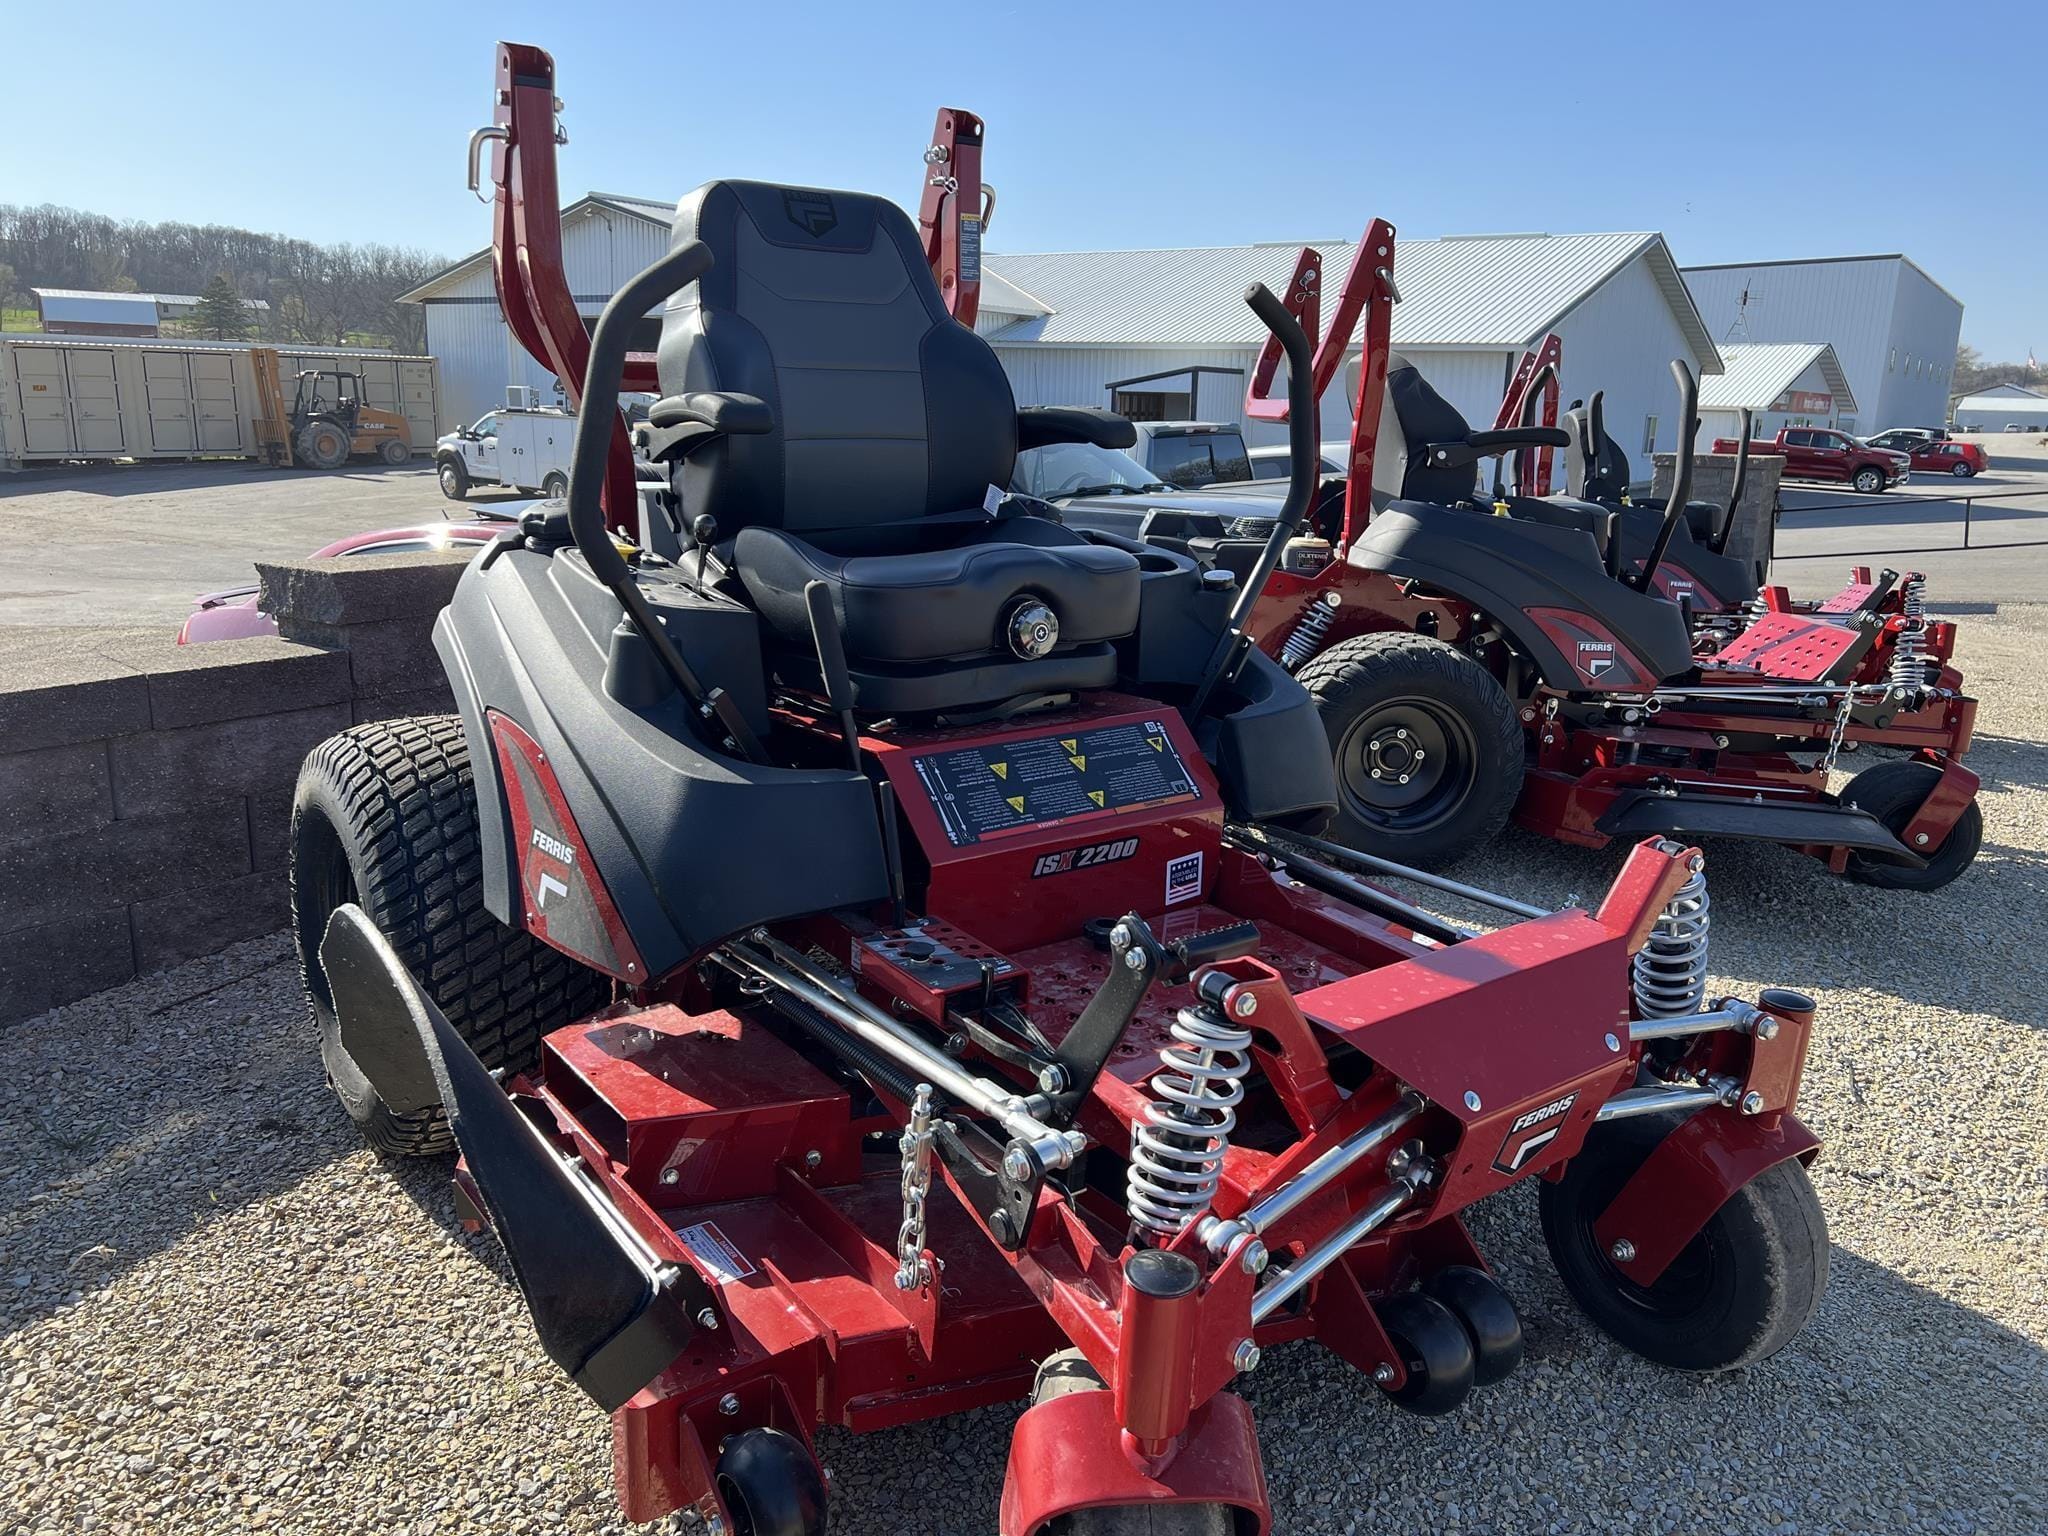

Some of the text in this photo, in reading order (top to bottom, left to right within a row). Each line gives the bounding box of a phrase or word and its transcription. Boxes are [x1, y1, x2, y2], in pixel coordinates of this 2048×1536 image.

[1580, 643, 1612, 651] FERRIS
[1037, 819, 1059, 828] DANGER
[532, 829, 573, 864] FERRIS
[1033, 838, 1139, 876] ISX 2200
[1511, 1095, 1575, 1133] FERRIS
[719, 1240, 738, 1259] DANGER
